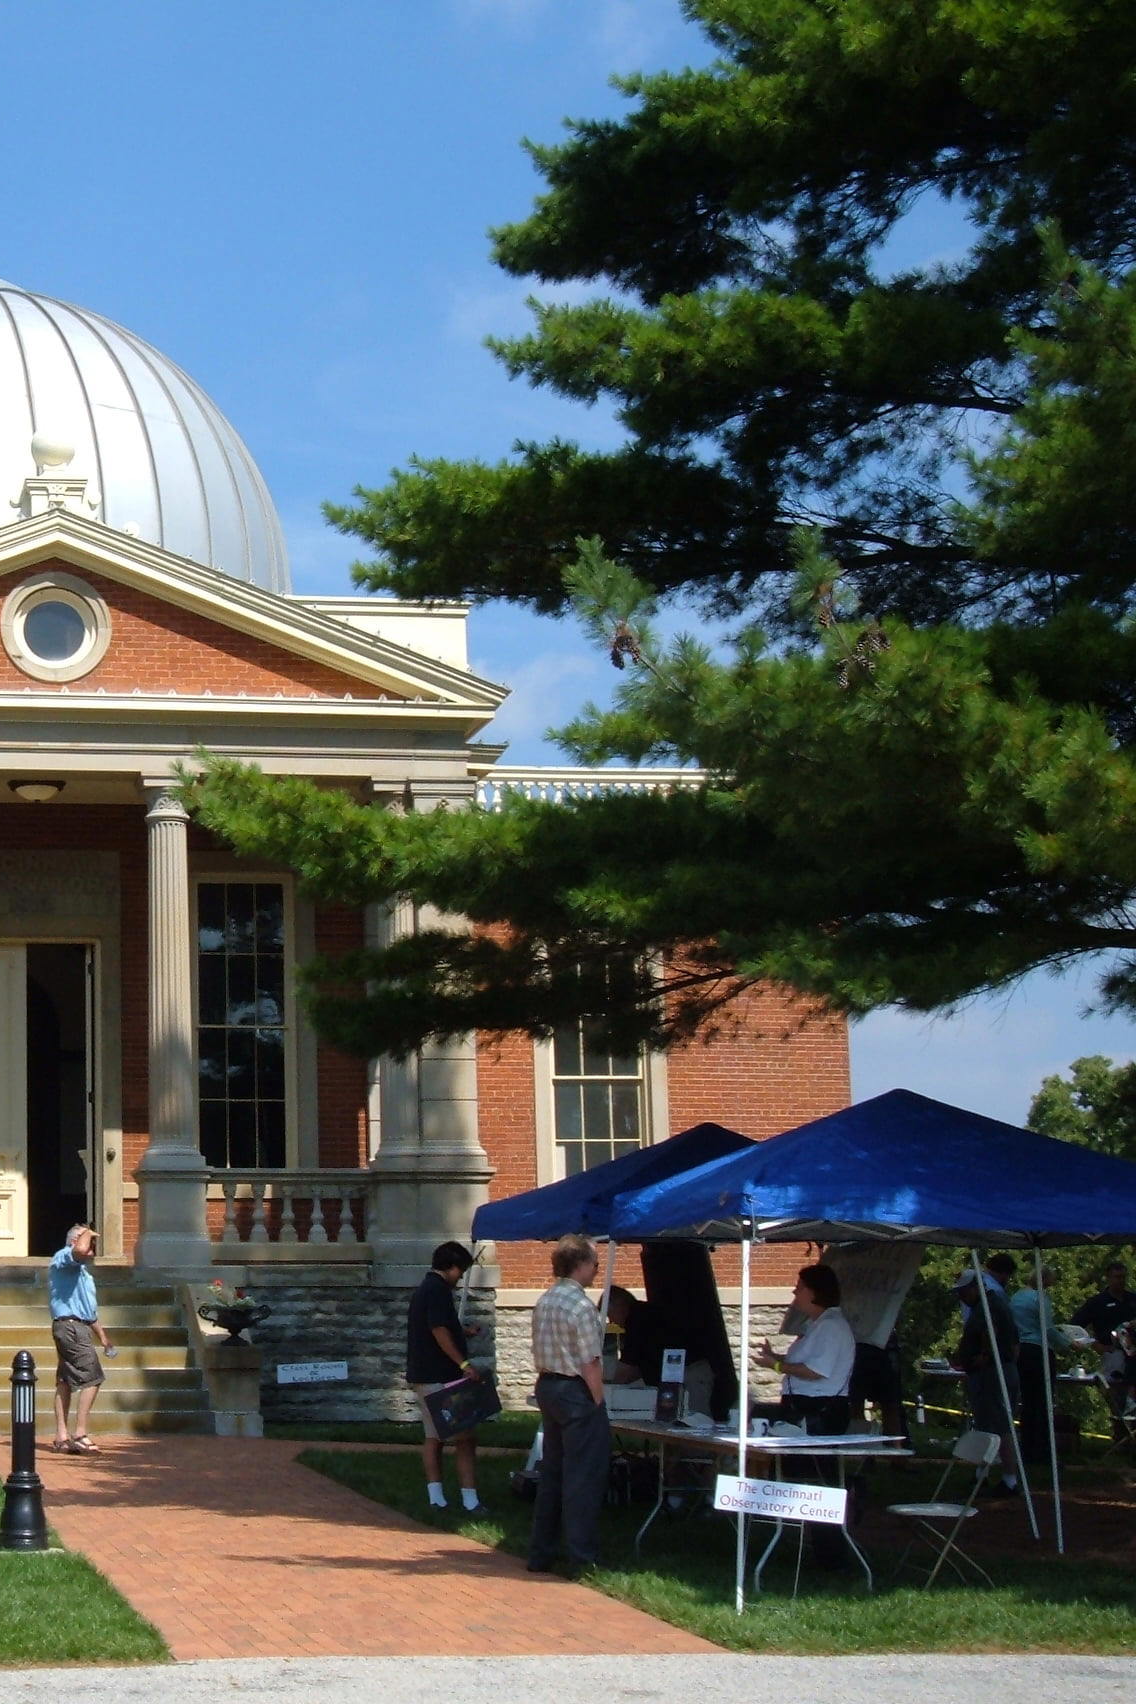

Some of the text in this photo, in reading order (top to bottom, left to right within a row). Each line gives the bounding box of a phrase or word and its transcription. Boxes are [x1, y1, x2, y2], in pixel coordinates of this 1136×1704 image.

[737, 1481, 823, 1501] The Cincinnati
[720, 1495, 840, 1518] Observatory Center
